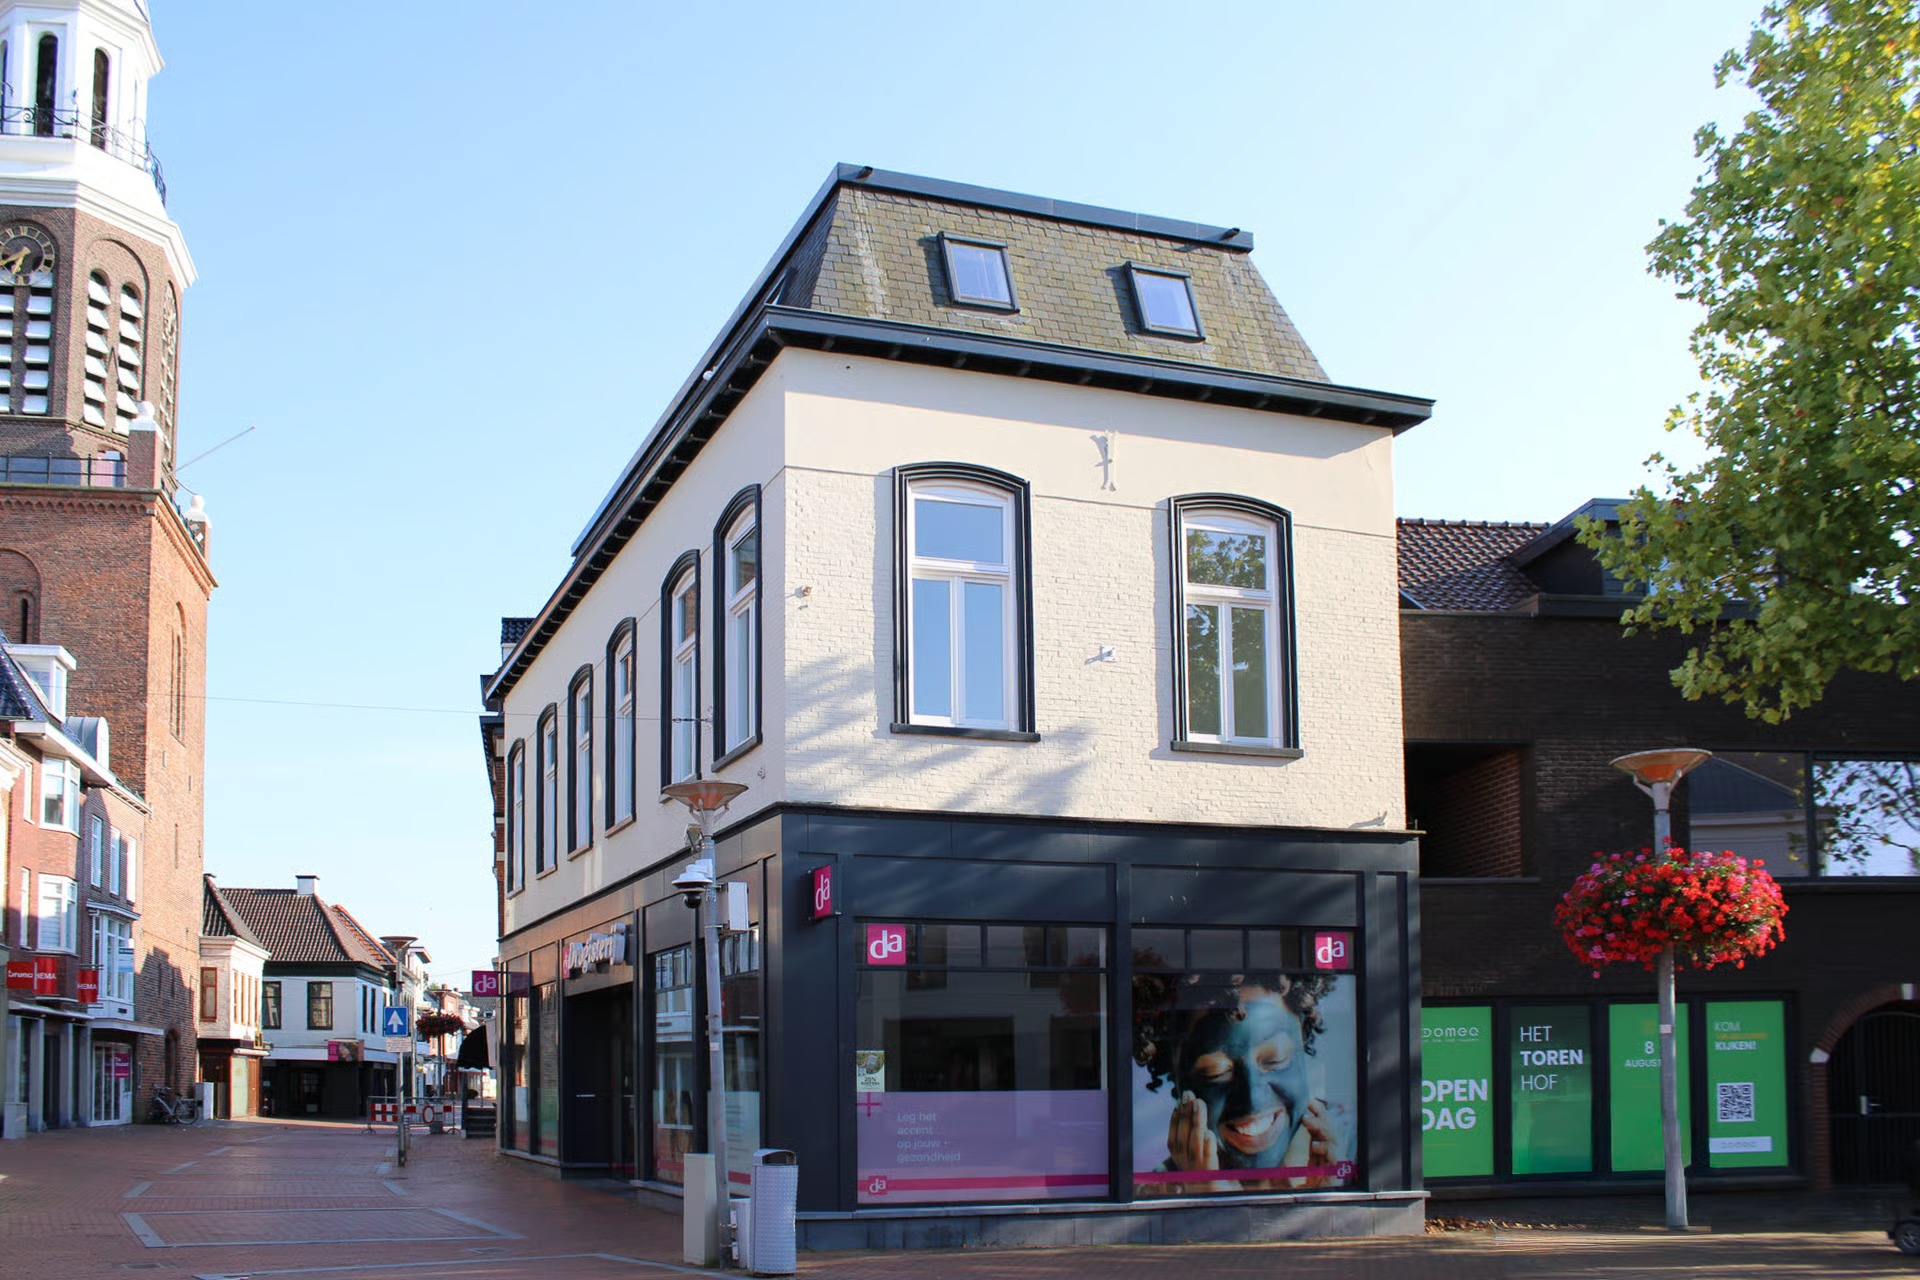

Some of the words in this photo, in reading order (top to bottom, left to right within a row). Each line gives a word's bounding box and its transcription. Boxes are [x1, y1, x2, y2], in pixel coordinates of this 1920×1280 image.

[815, 874, 830, 911] da
[869, 930, 903, 959] da
[1317, 936, 1345, 963] da
[36, 972, 57, 980] HEMA
[474, 974, 497, 993] da
[1520, 1026, 1552, 1042] HET
[1644, 1041, 1655, 1055] 8
[1520, 1049, 1584, 1066] TOREN
[1624, 1058, 1662, 1068] AUGUST
[1521, 1074, 1558, 1091] HOF
[1422, 1079, 1488, 1103] OPEN
[897, 1112, 916, 1123] Leg
[919, 1112, 937, 1121] het
[1422, 1106, 1477, 1131] DAG
[897, 1126, 934, 1135] accent
[897, 1140, 912, 1150] op
[914, 1139, 941, 1150] jouw
[896, 1152, 961, 1164] gezondheid
[1337, 1163, 1352, 1177] da
[869, 1178, 887, 1193] da
